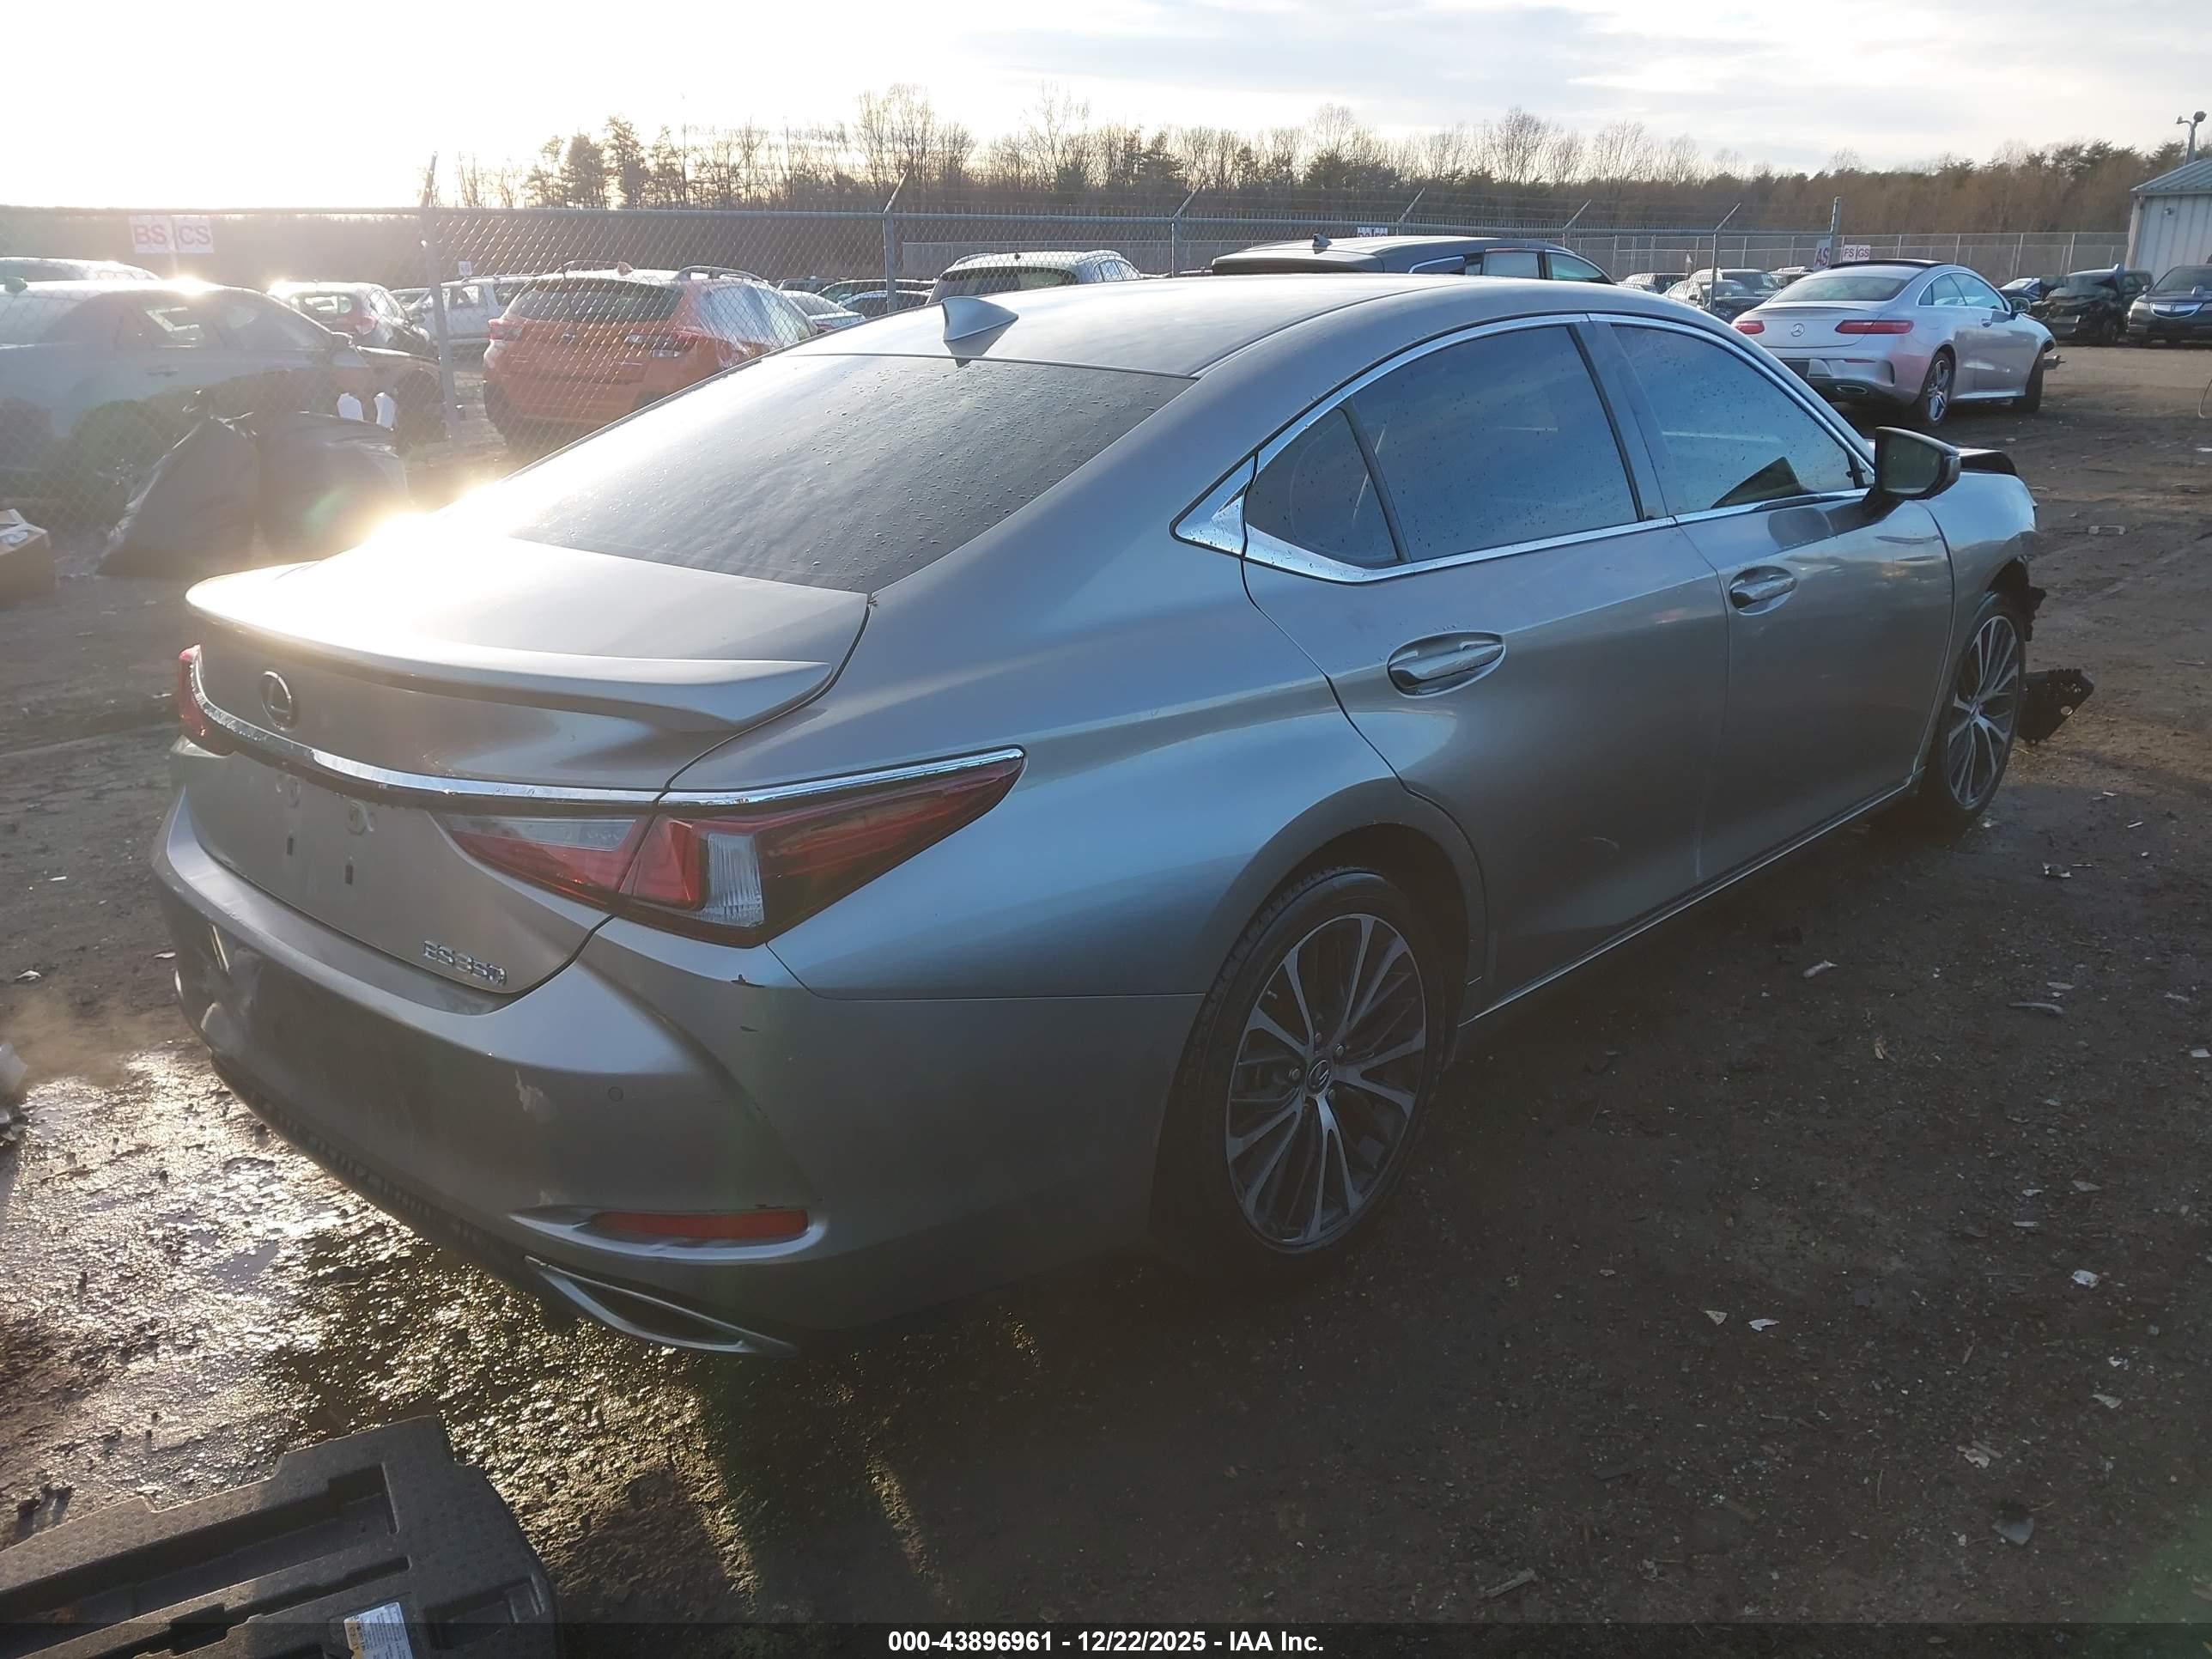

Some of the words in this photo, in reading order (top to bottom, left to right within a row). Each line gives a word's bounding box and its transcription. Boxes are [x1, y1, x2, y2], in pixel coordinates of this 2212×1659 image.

[134, 225, 167, 245] BS
[179, 225, 211, 245] CS
[1814, 246, 1829, 266] AS
[1844, 247, 1855, 258] FS
[1857, 247, 1869, 258] GS
